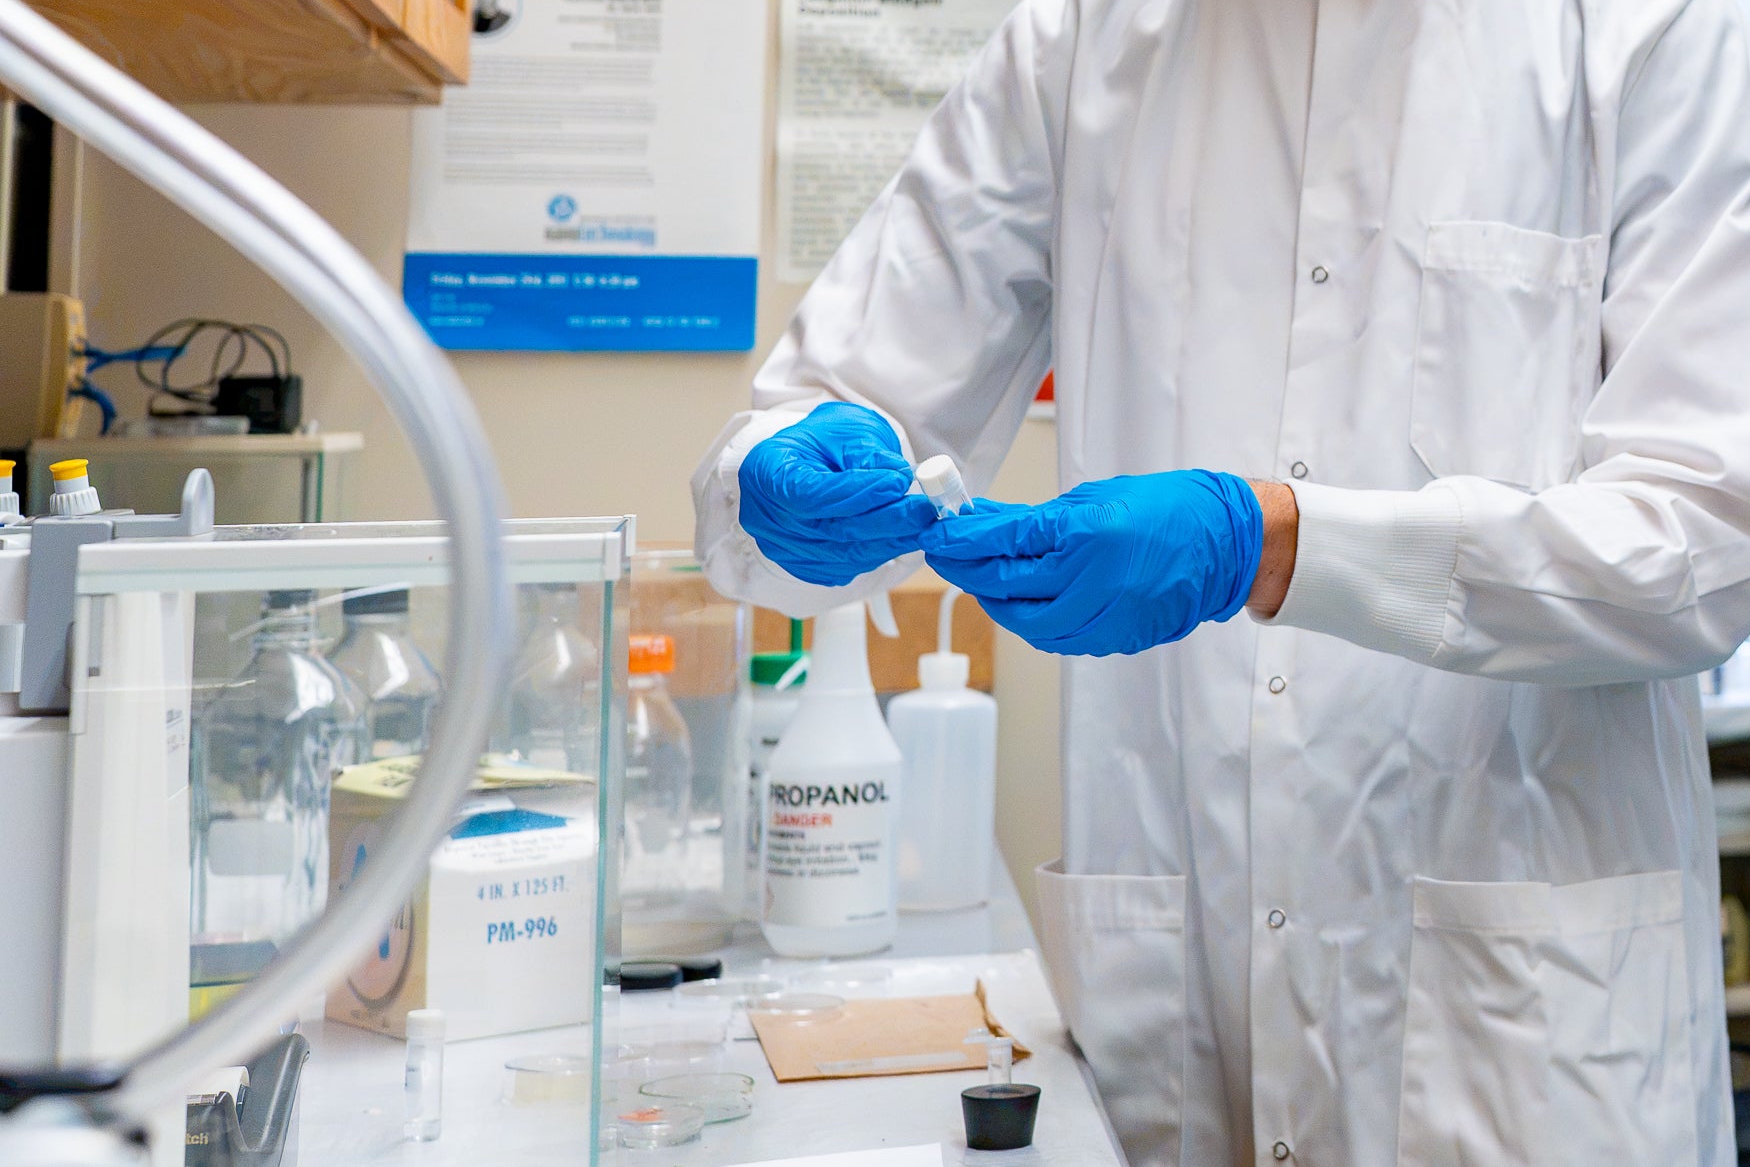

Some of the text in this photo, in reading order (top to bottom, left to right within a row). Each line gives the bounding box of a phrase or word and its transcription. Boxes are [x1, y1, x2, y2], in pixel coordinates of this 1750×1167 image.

[769, 780, 889, 807] PROPANOL
[526, 878, 548, 896] 125
[486, 916, 558, 944] PM-996
